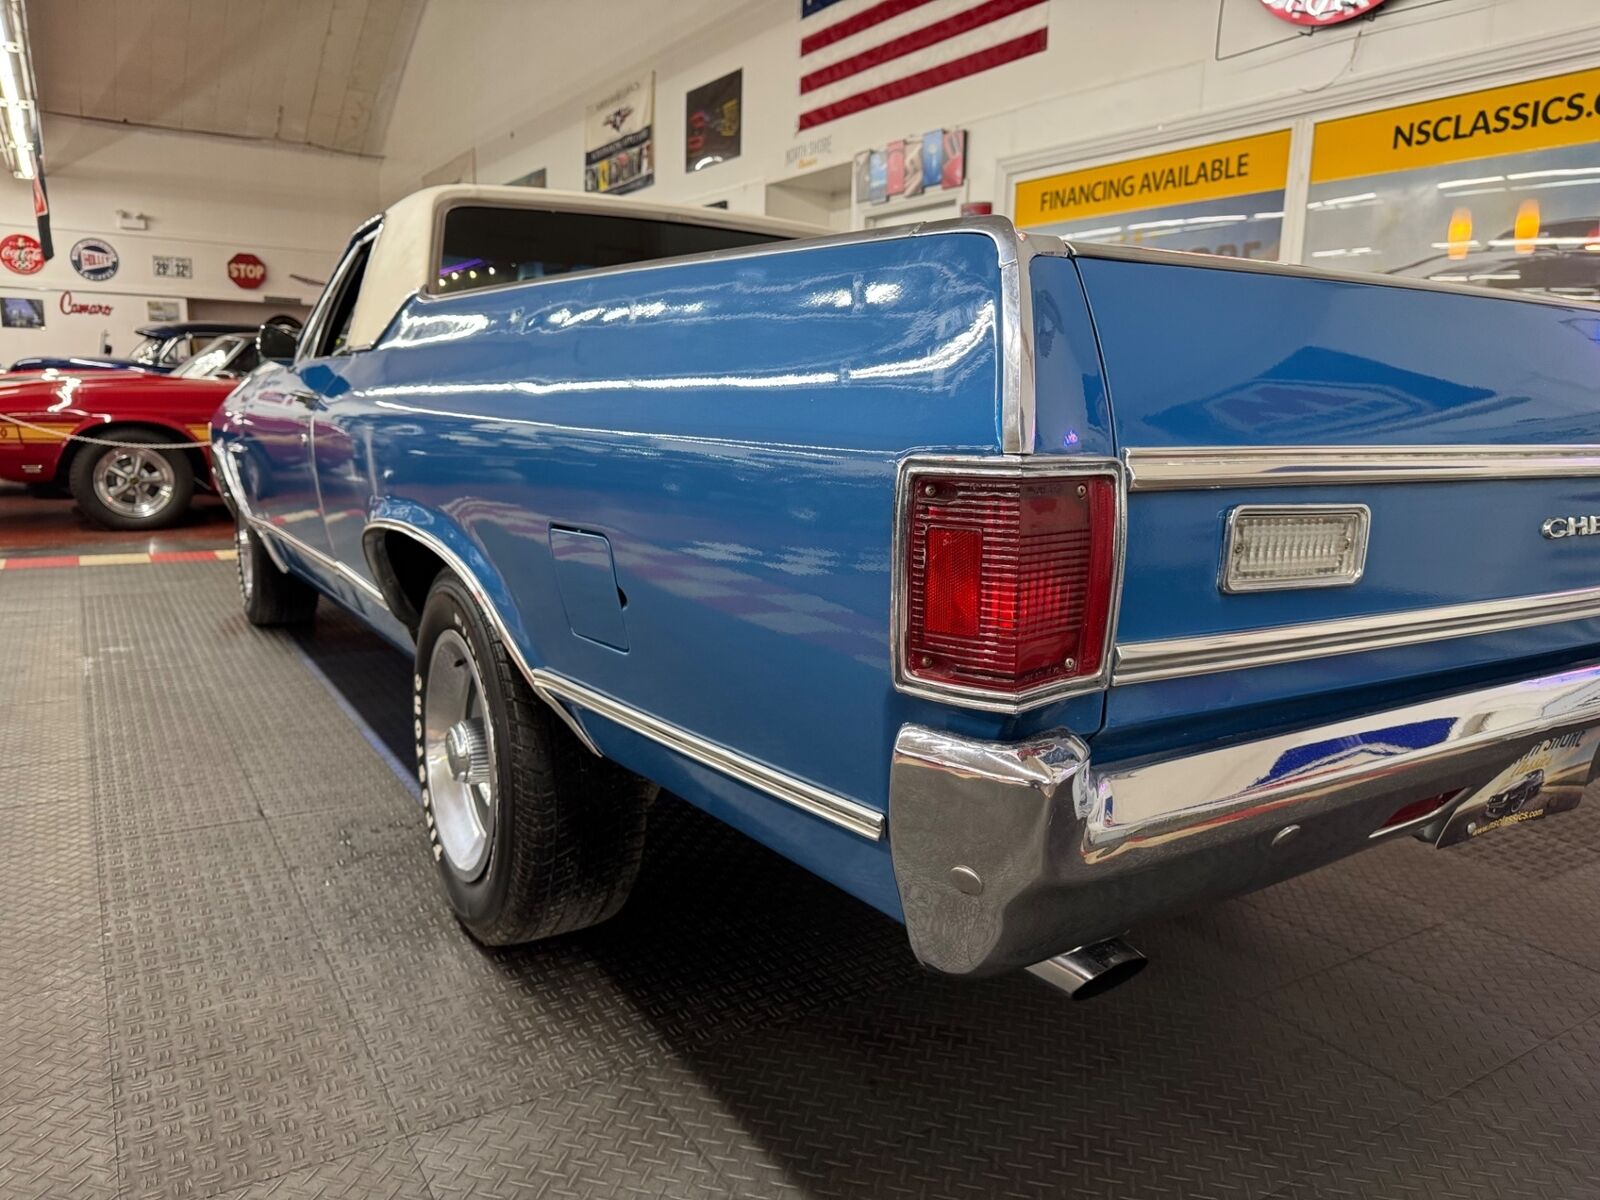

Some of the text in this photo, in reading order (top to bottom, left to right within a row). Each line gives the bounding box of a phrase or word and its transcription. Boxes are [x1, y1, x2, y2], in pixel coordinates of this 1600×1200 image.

[1393, 92, 1600, 150] NSCLASSICS.
[1040, 153, 1249, 212] FINANCING AVAILABLE
[229, 263, 264, 279] STOP
[60, 290, 114, 316] Camaro
